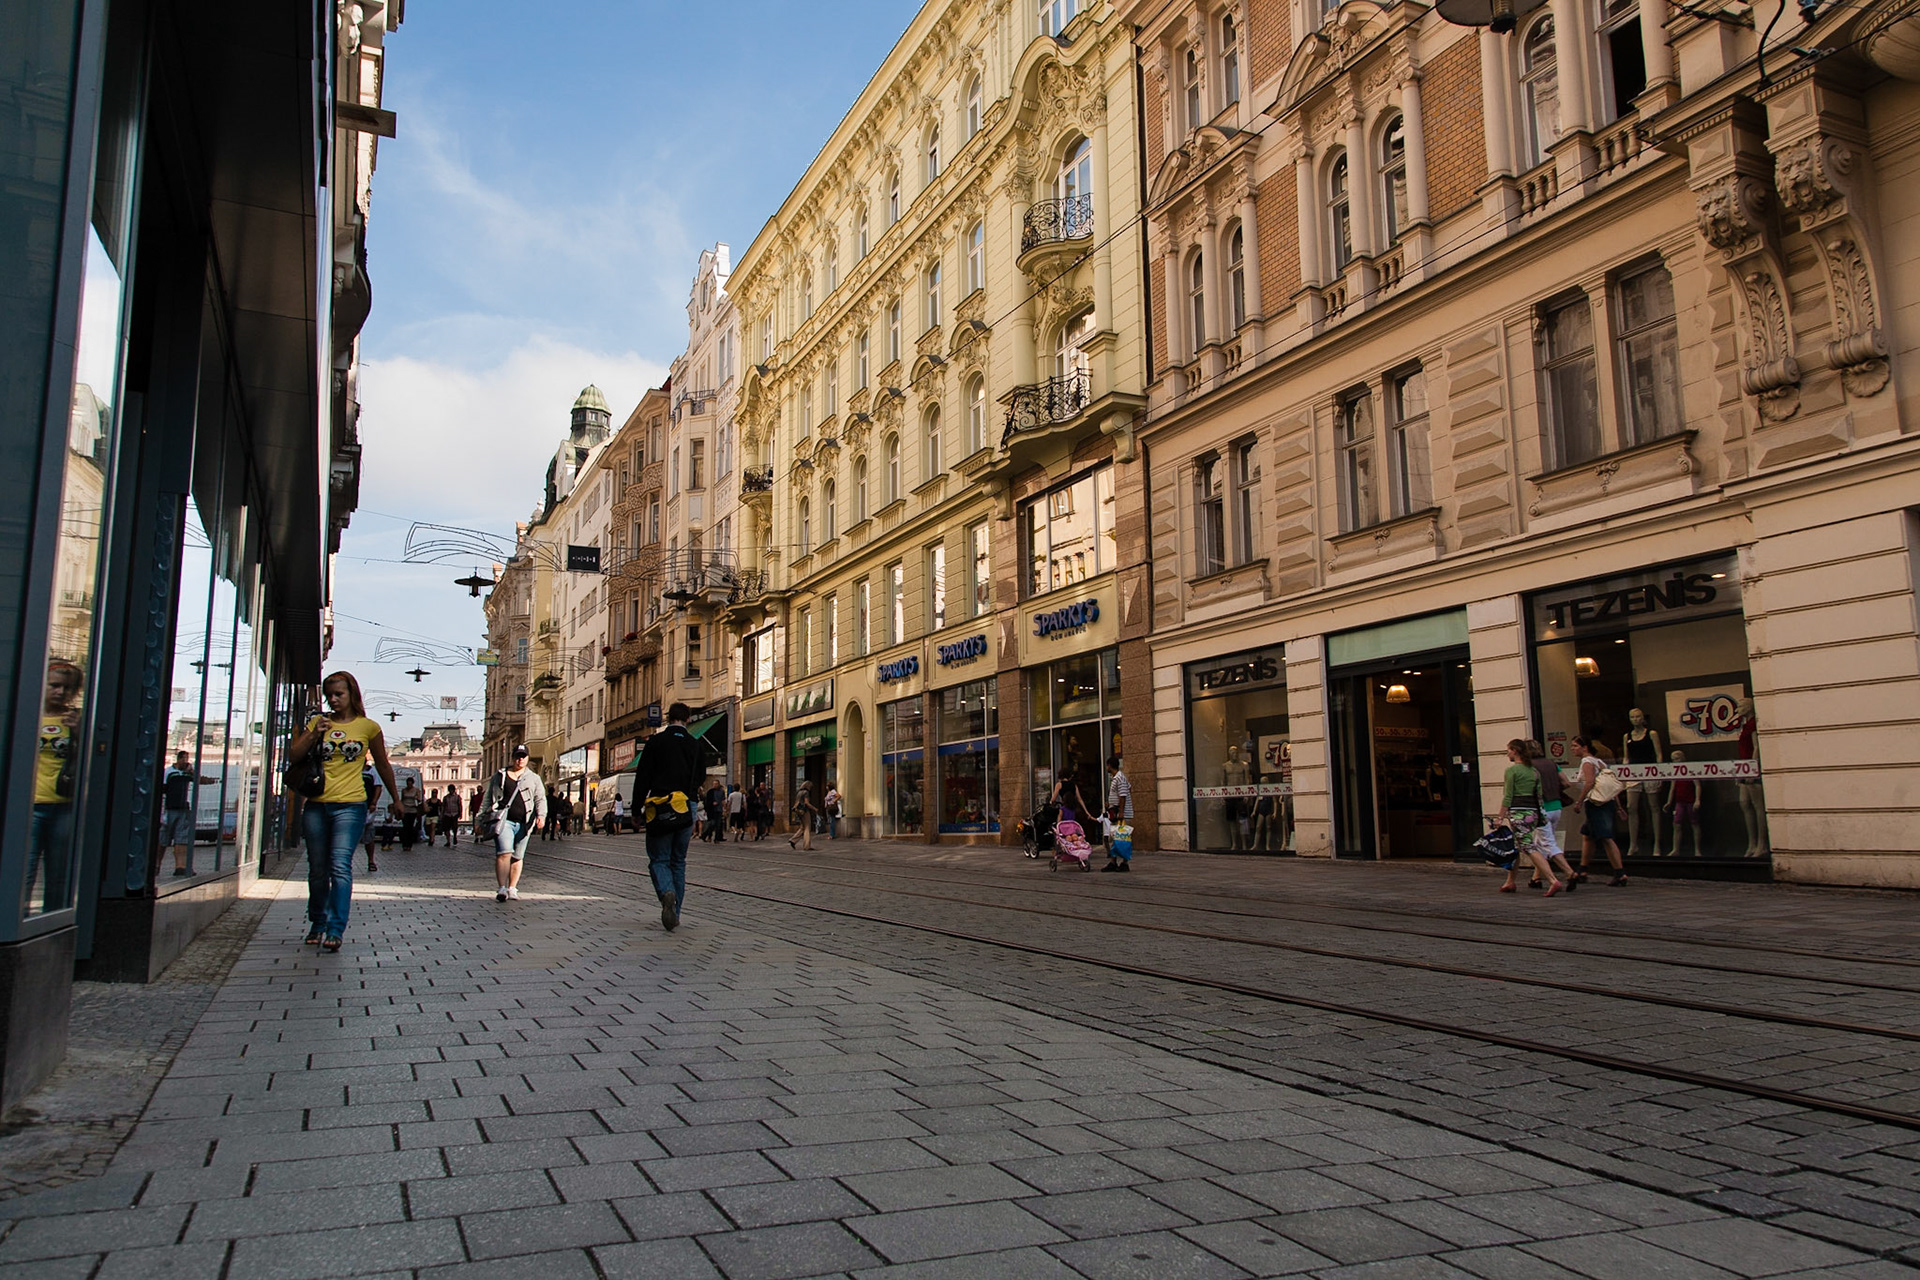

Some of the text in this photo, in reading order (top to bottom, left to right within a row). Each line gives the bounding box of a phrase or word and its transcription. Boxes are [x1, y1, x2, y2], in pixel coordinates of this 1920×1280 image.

[1032, 598, 1099, 636] SPARKYS
[936, 634, 987, 665] SPARKYS
[877, 656, 919, 682] SPARKYS
